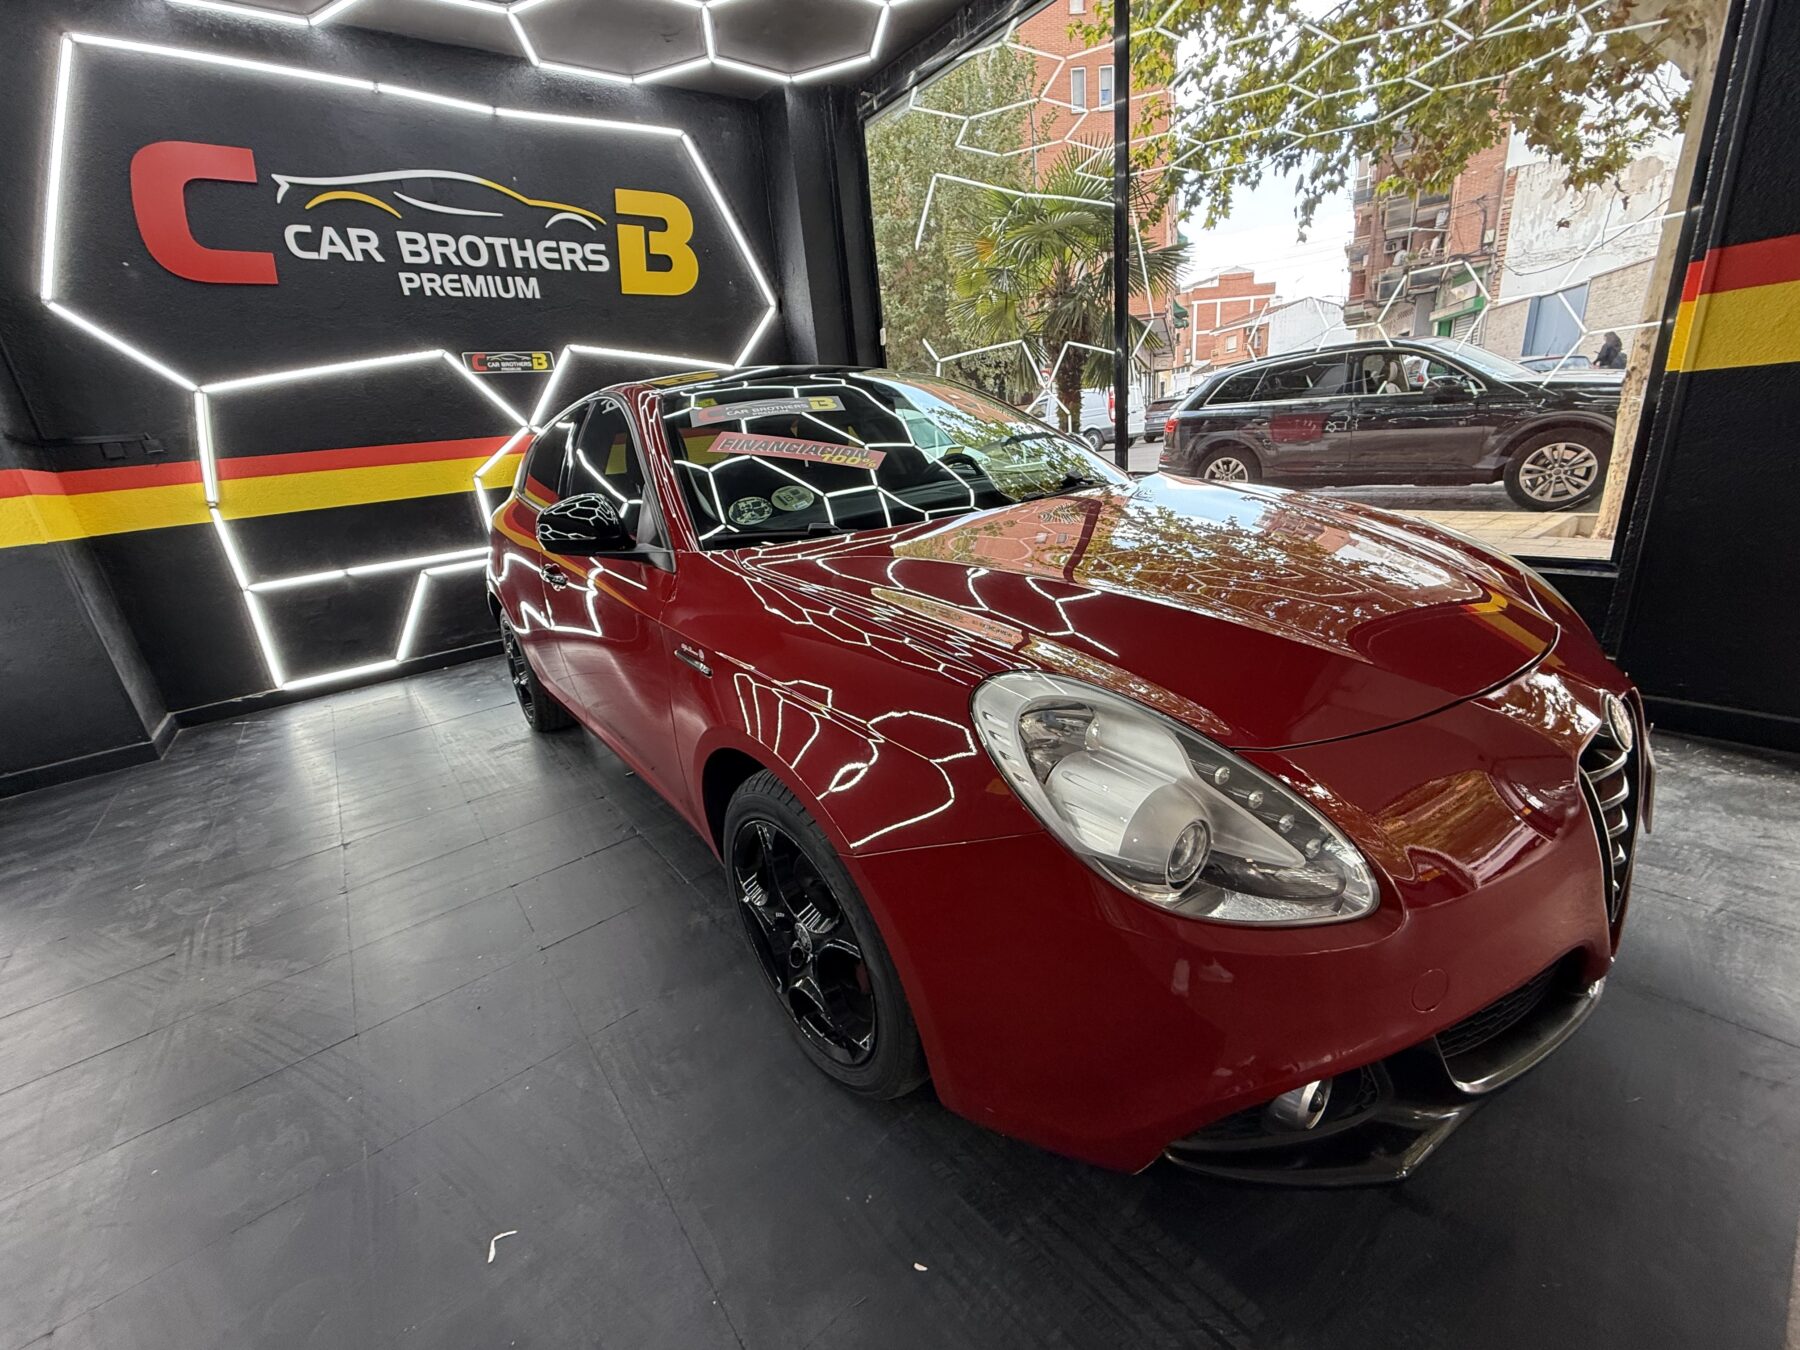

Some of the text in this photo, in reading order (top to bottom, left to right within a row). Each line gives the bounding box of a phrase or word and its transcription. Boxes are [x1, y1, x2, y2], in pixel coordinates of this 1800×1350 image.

[130, 140, 279, 285] C
[284, 224, 610, 272] CAR BROTHERS
[615, 188, 699, 296] B
[398, 271, 541, 300] PREMIUM
[472, 353, 488, 371] C
[532, 353, 548, 370] B
[726, 404, 808, 417] CAR BROTHERS
[809, 397, 837, 410] B
